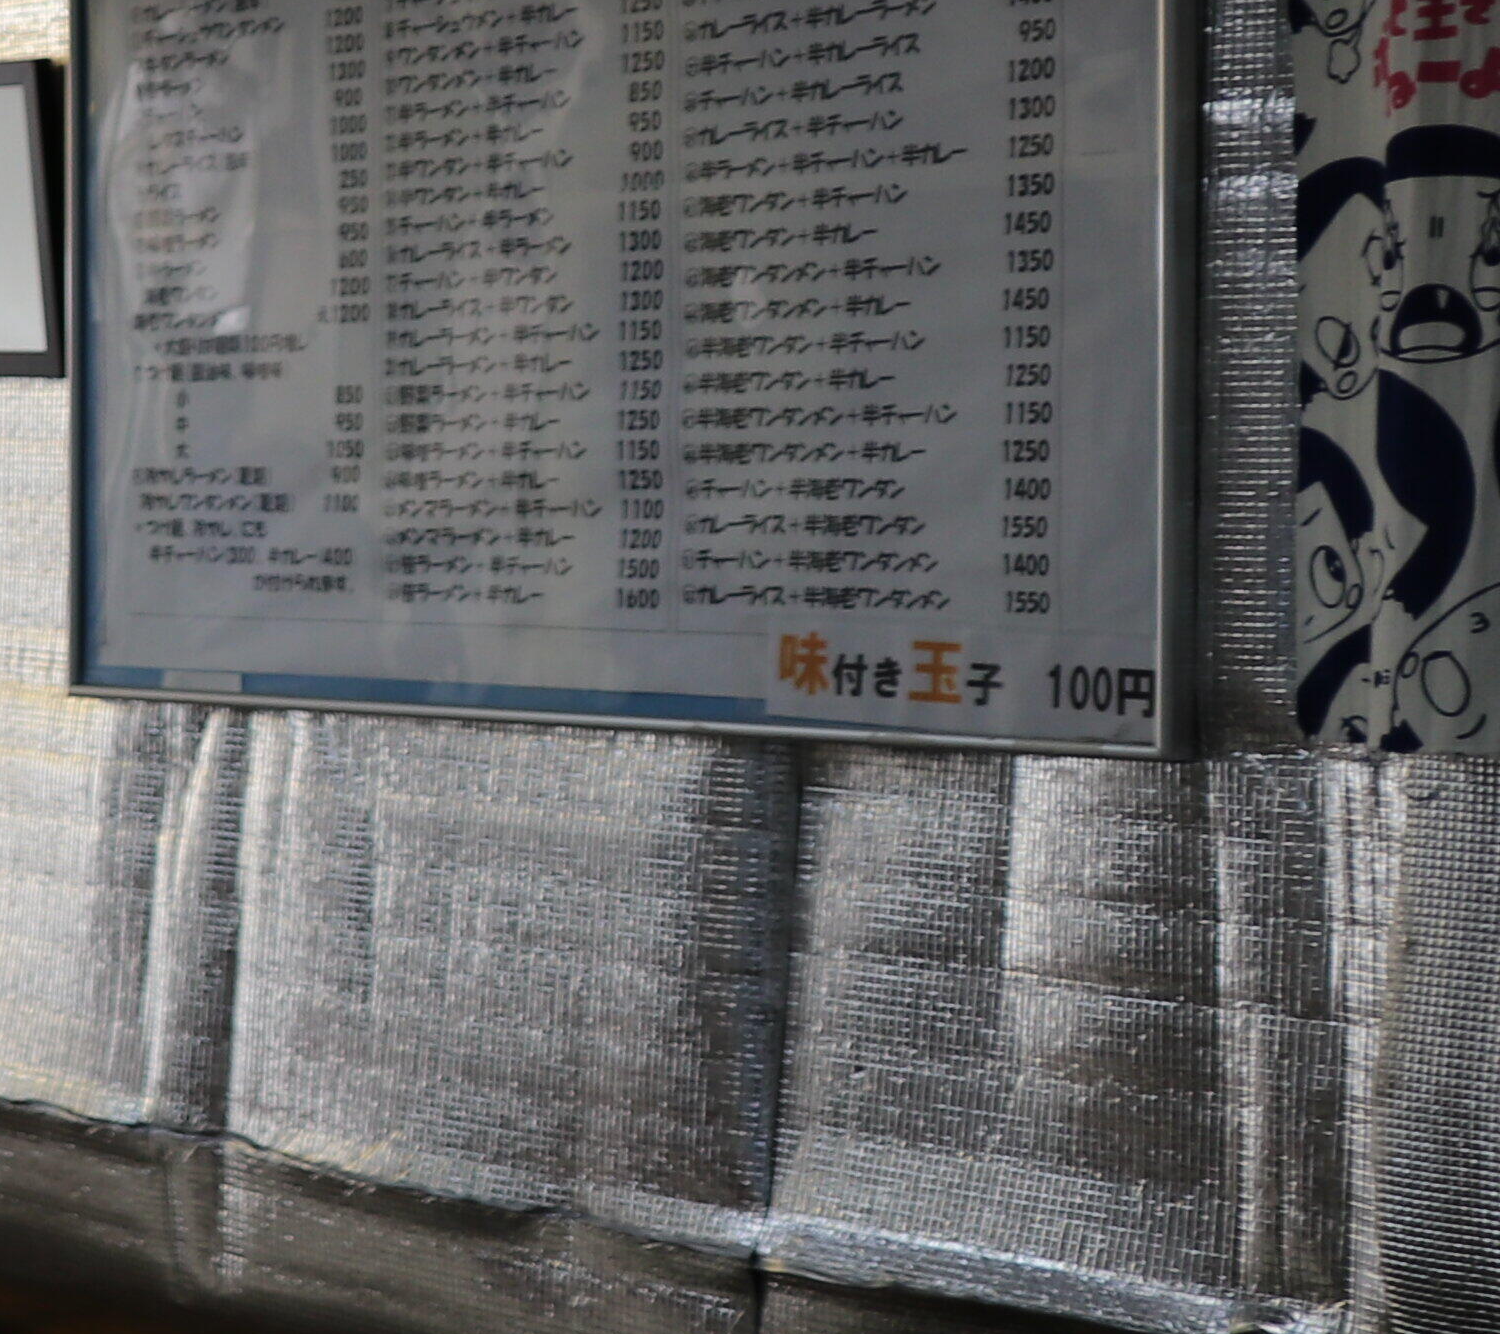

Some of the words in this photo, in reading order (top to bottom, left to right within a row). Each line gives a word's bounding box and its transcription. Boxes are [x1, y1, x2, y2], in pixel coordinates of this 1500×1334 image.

[622, 21, 664, 43] 1150
[1018, 18, 1055, 42] 950
[622, 51, 665, 73] 1250
[1007, 57, 1055, 82] 1200
[629, 81, 662, 103] 850
[1009, 96, 1055, 121] 1300
[629, 111, 662, 132] 950
[629, 140, 664, 162] 900
[1009, 134, 1055, 158] 1250
[1006, 171, 1055, 196] 1350
[618, 201, 661, 222] 1150
[1003, 210, 1052, 234] 1450
[618, 230, 662, 252] 1300
[620, 260, 664, 282] 1200
[1008, 248, 1054, 273] 1350
[620, 290, 664, 312] 1300
[1002, 286, 1050, 311] 1450
[620, 321, 663, 342] 1150
[1003, 324, 1051, 349] 1150
[620, 350, 664, 371] 1250
[1006, 363, 1052, 387] 1250
[620, 381, 662, 402] 1150
[618, 410, 660, 431] 1250
[1004, 401, 1052, 425] 1150
[617, 440, 660, 461] 1150
[1002, 439, 1050, 463] 1250
[618, 469, 662, 490] 1250
[1003, 476, 1052, 500] 1400
[620, 499, 664, 519] 1100
[1002, 514, 1048, 539] 1550
[620, 528, 662, 549] 1200
[618, 557, 660, 579] 1500
[1003, 552, 1049, 576] 1400
[1006, 589, 1050, 614] 1550
[778, 631, 1004, 707] 味付き玉子
[1048, 664, 1156, 719] 100円
